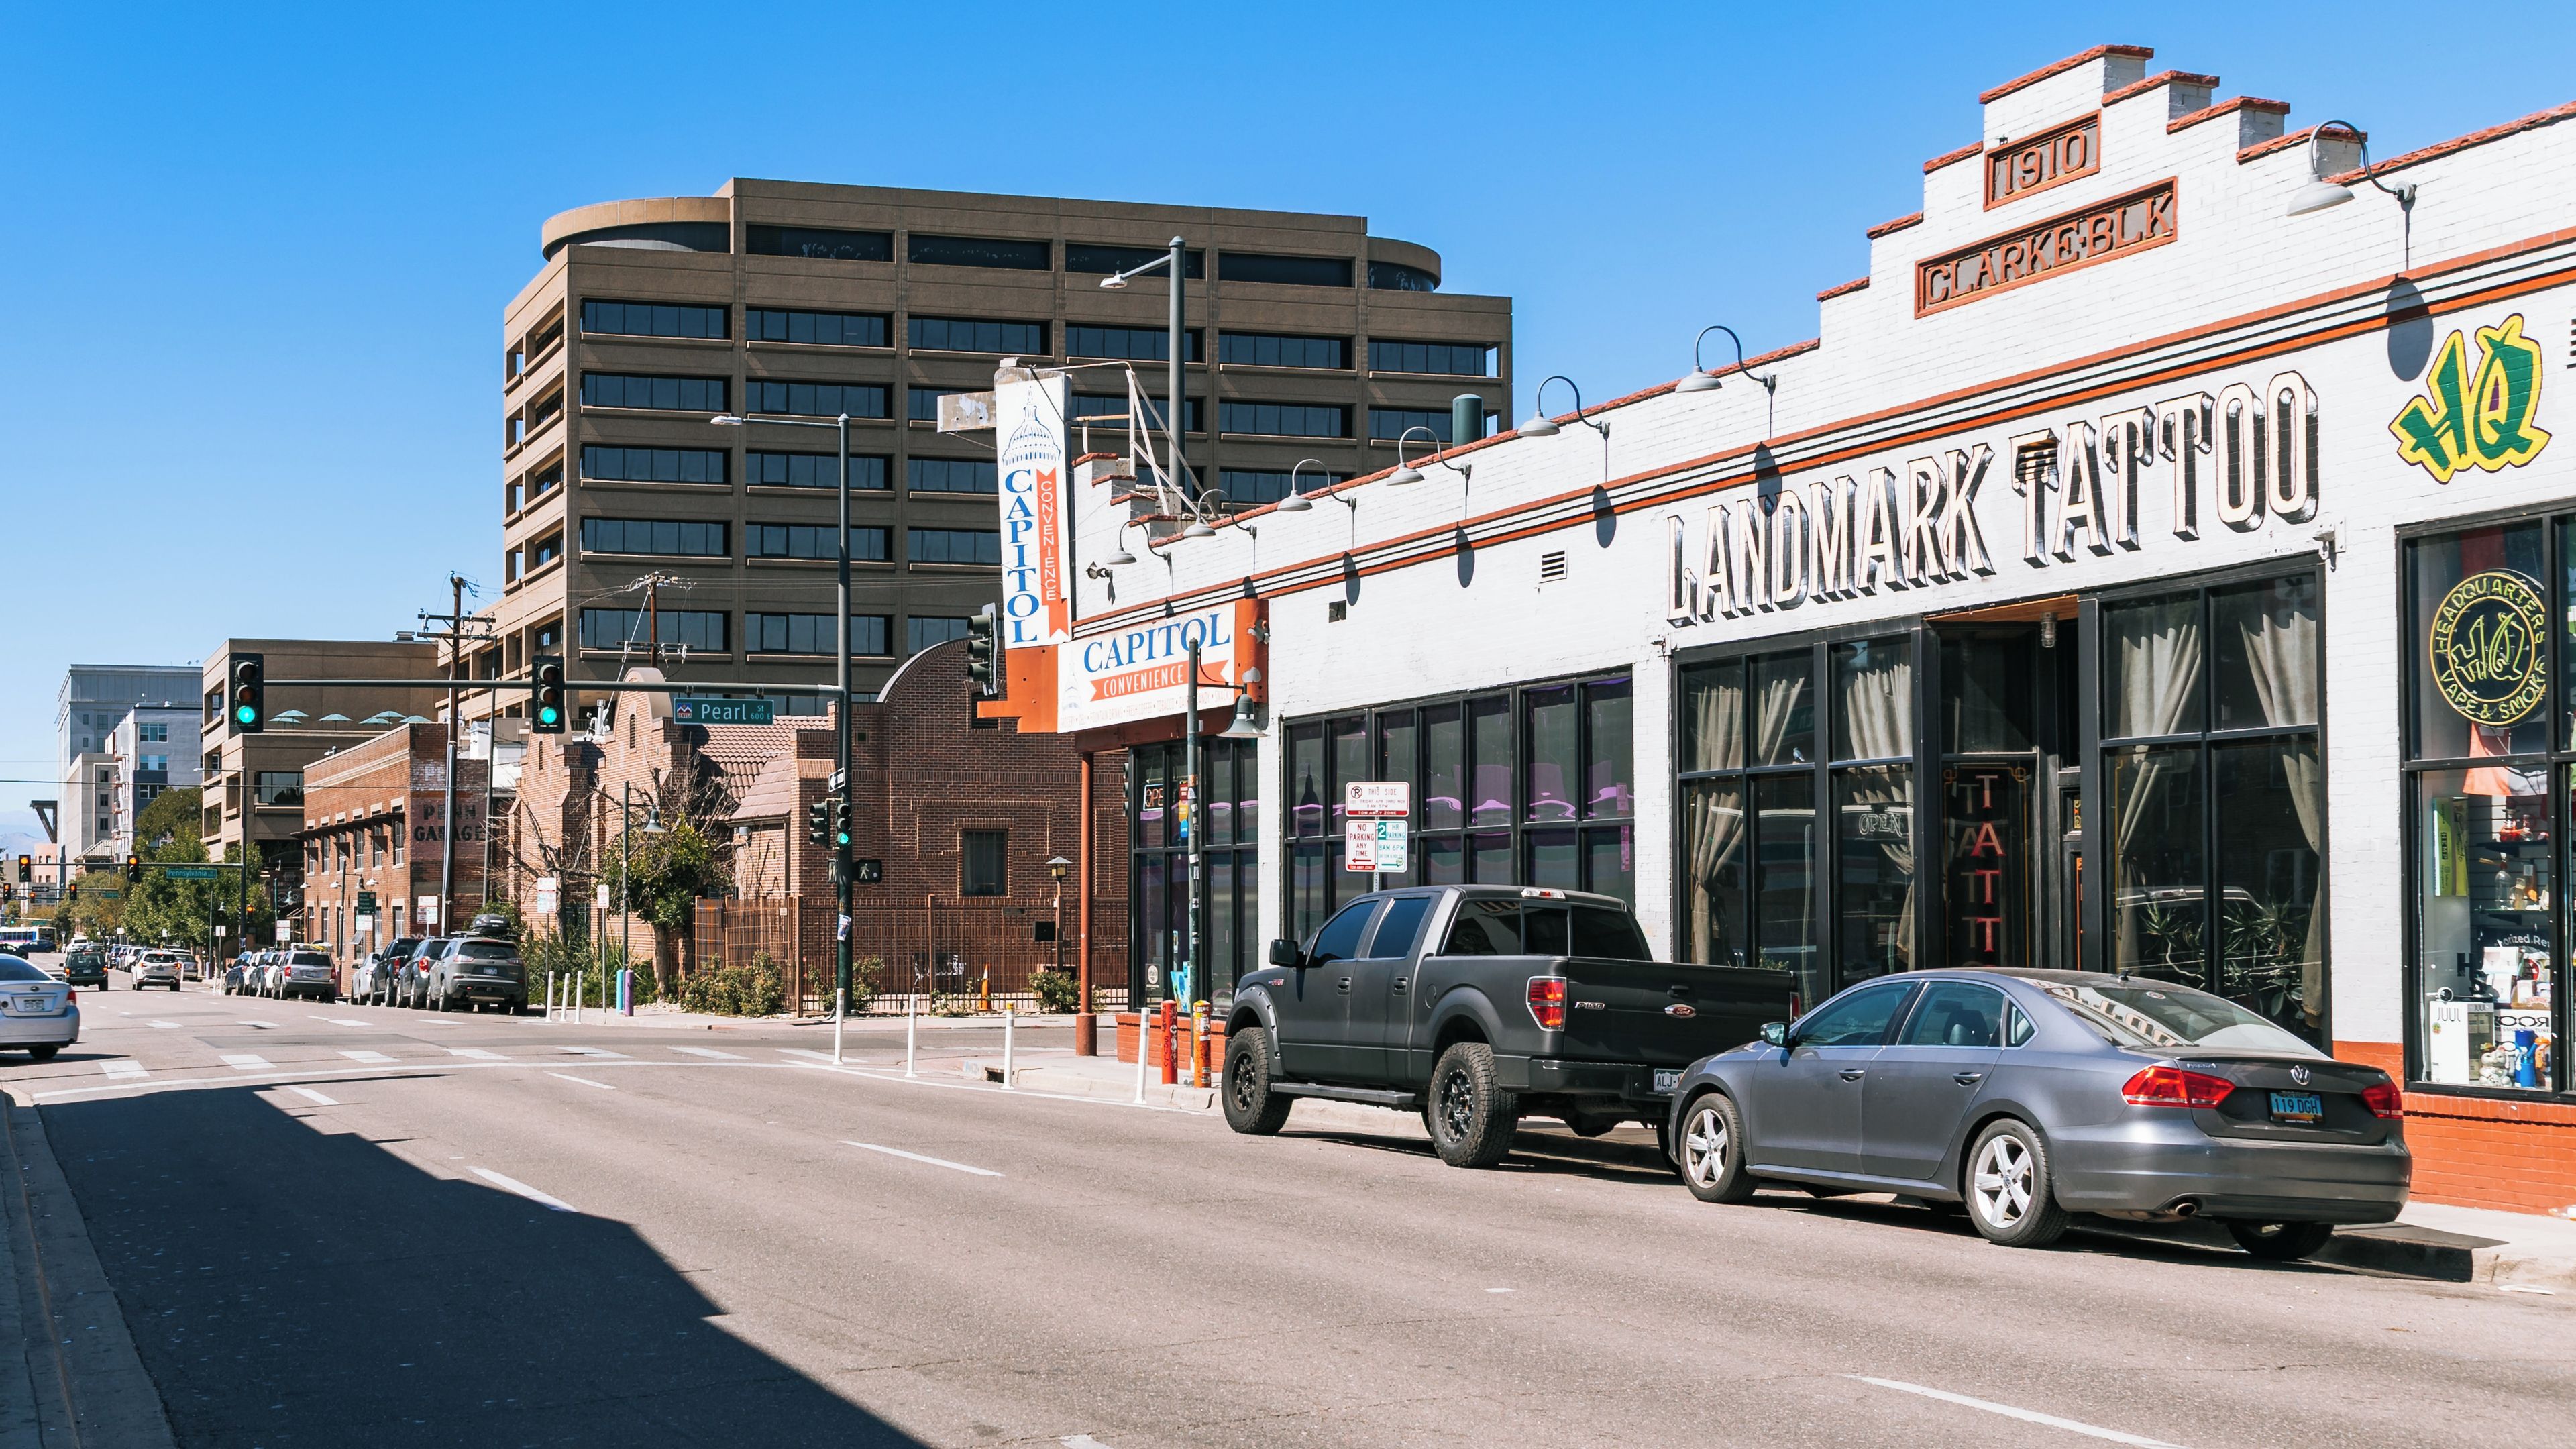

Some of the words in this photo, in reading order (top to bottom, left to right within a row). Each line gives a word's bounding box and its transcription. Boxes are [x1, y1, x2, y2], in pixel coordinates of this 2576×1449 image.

[2004, 130, 2086, 195] 1910
[2388, 313, 2552, 484] HQ
[1666, 442, 1996, 627] LANDMARK
[2009, 370, 2320, 569] TATTOO
[1005, 469, 1039, 643] CAPITOL
[1040, 480, 1056, 600] CONVENIENCE
[2436, 578, 2545, 653] HEADQUARTERS
[1084, 613, 1230, 673] CAPITOL
[1103, 665, 1183, 697] CONVENIENCE
[2439, 669, 2479, 715] VAPE
[2480, 703, 2491, 719] &
[2499, 655, 2546, 720] SMOKE
[702, 704, 746, 720] Pearl
[1145, 788, 1163, 807] OPE
[1378, 824, 1386, 838] 2
[1858, 813, 1902, 837] OPEN
[168, 869, 207, 877] Pennsylvania
[1970, 775, 2006, 952] TATT
[1676, 1007, 1690, 1015] Ford
[2437, 1007, 2460, 1022] JUUL
[2275, 1098, 2294, 1112] 119
[2297, 1099, 2318, 1114] DGH
